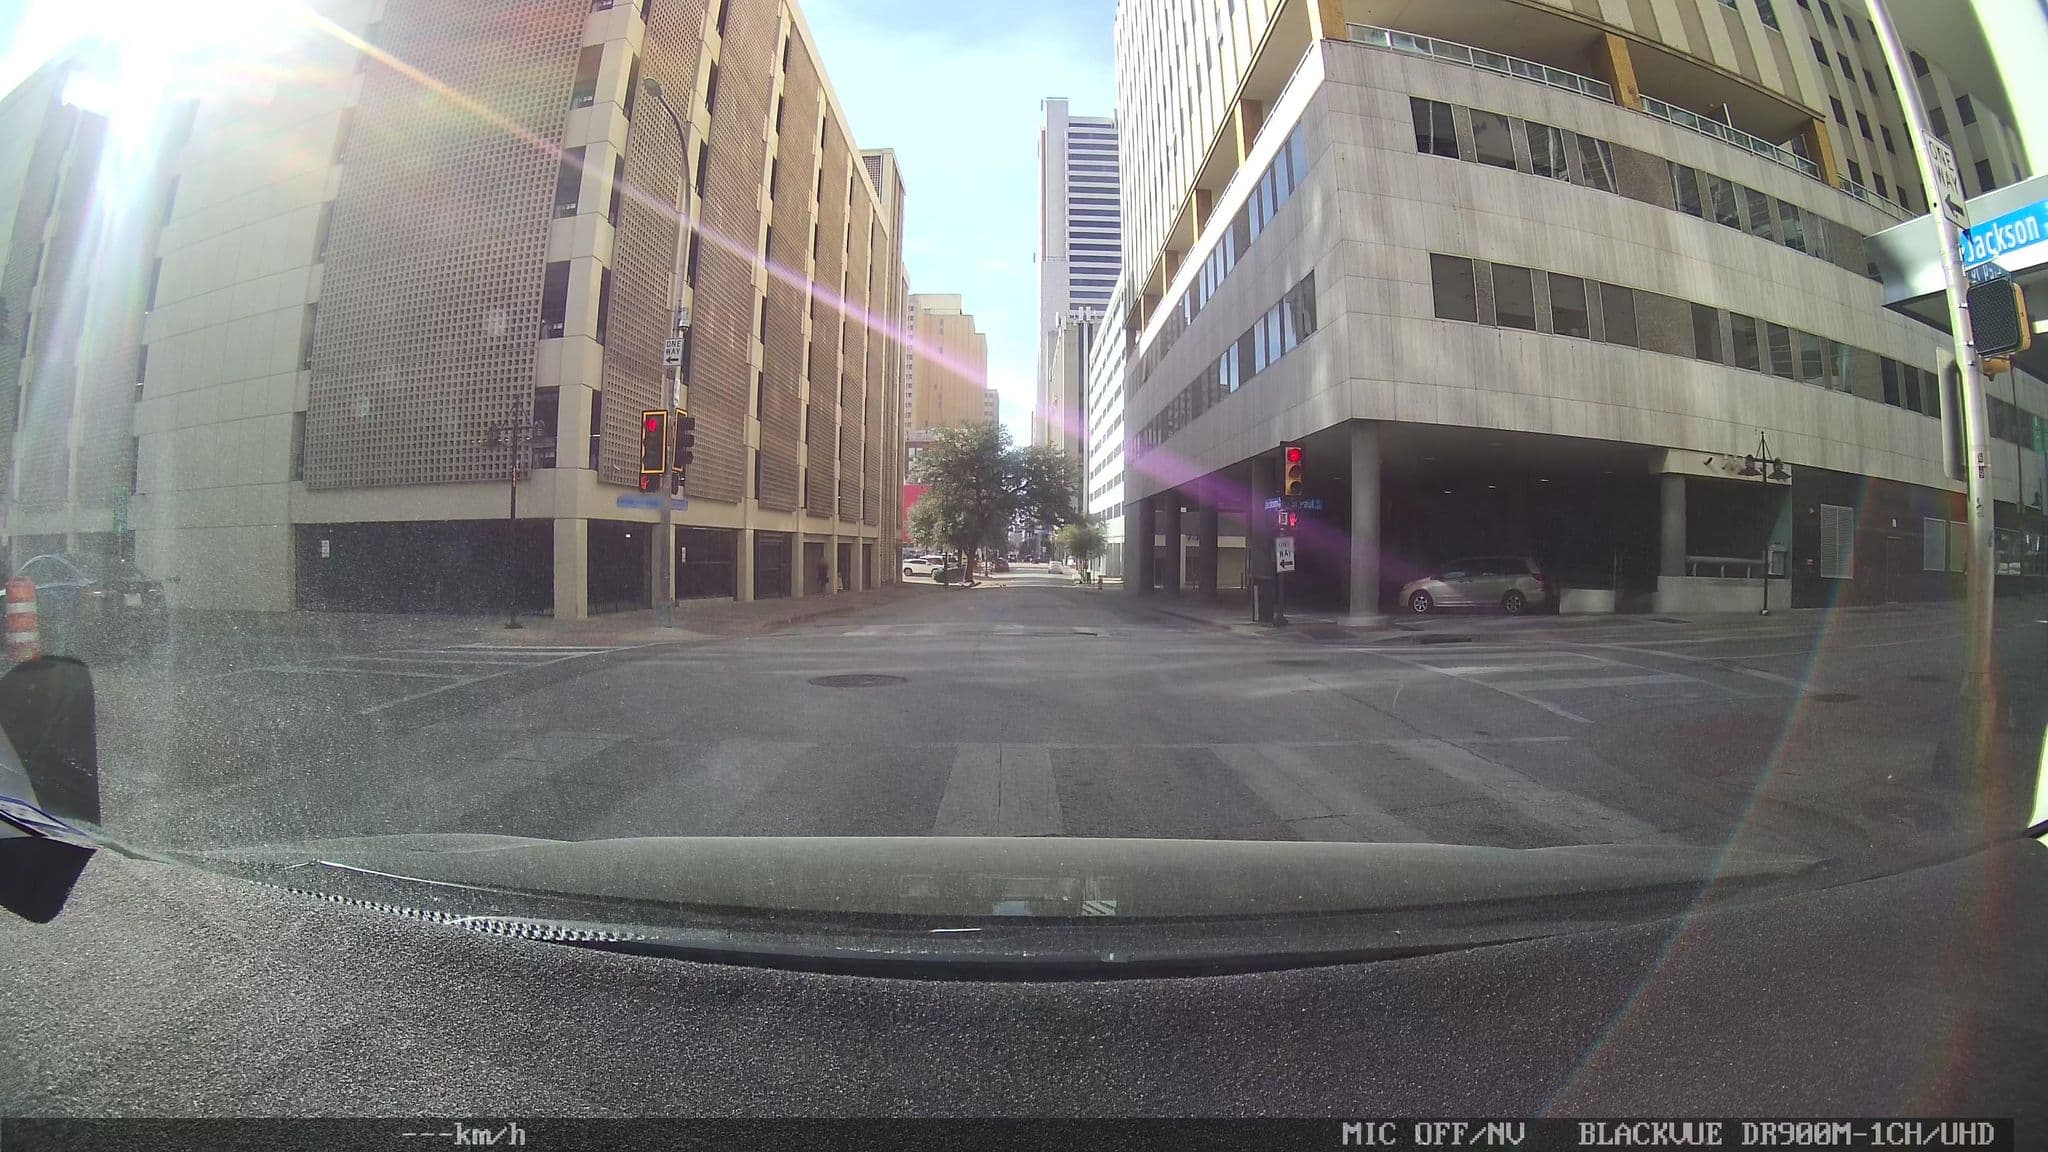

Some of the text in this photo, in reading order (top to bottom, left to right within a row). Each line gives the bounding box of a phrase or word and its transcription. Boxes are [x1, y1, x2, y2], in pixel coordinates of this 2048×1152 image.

[1929, 141, 1954, 172] ONE
[1936, 164, 1959, 195] WAY
[1967, 215, 2040, 263] Jackson
[665, 347, 681, 356] WAY
[666, 340, 682, 348] ONE
